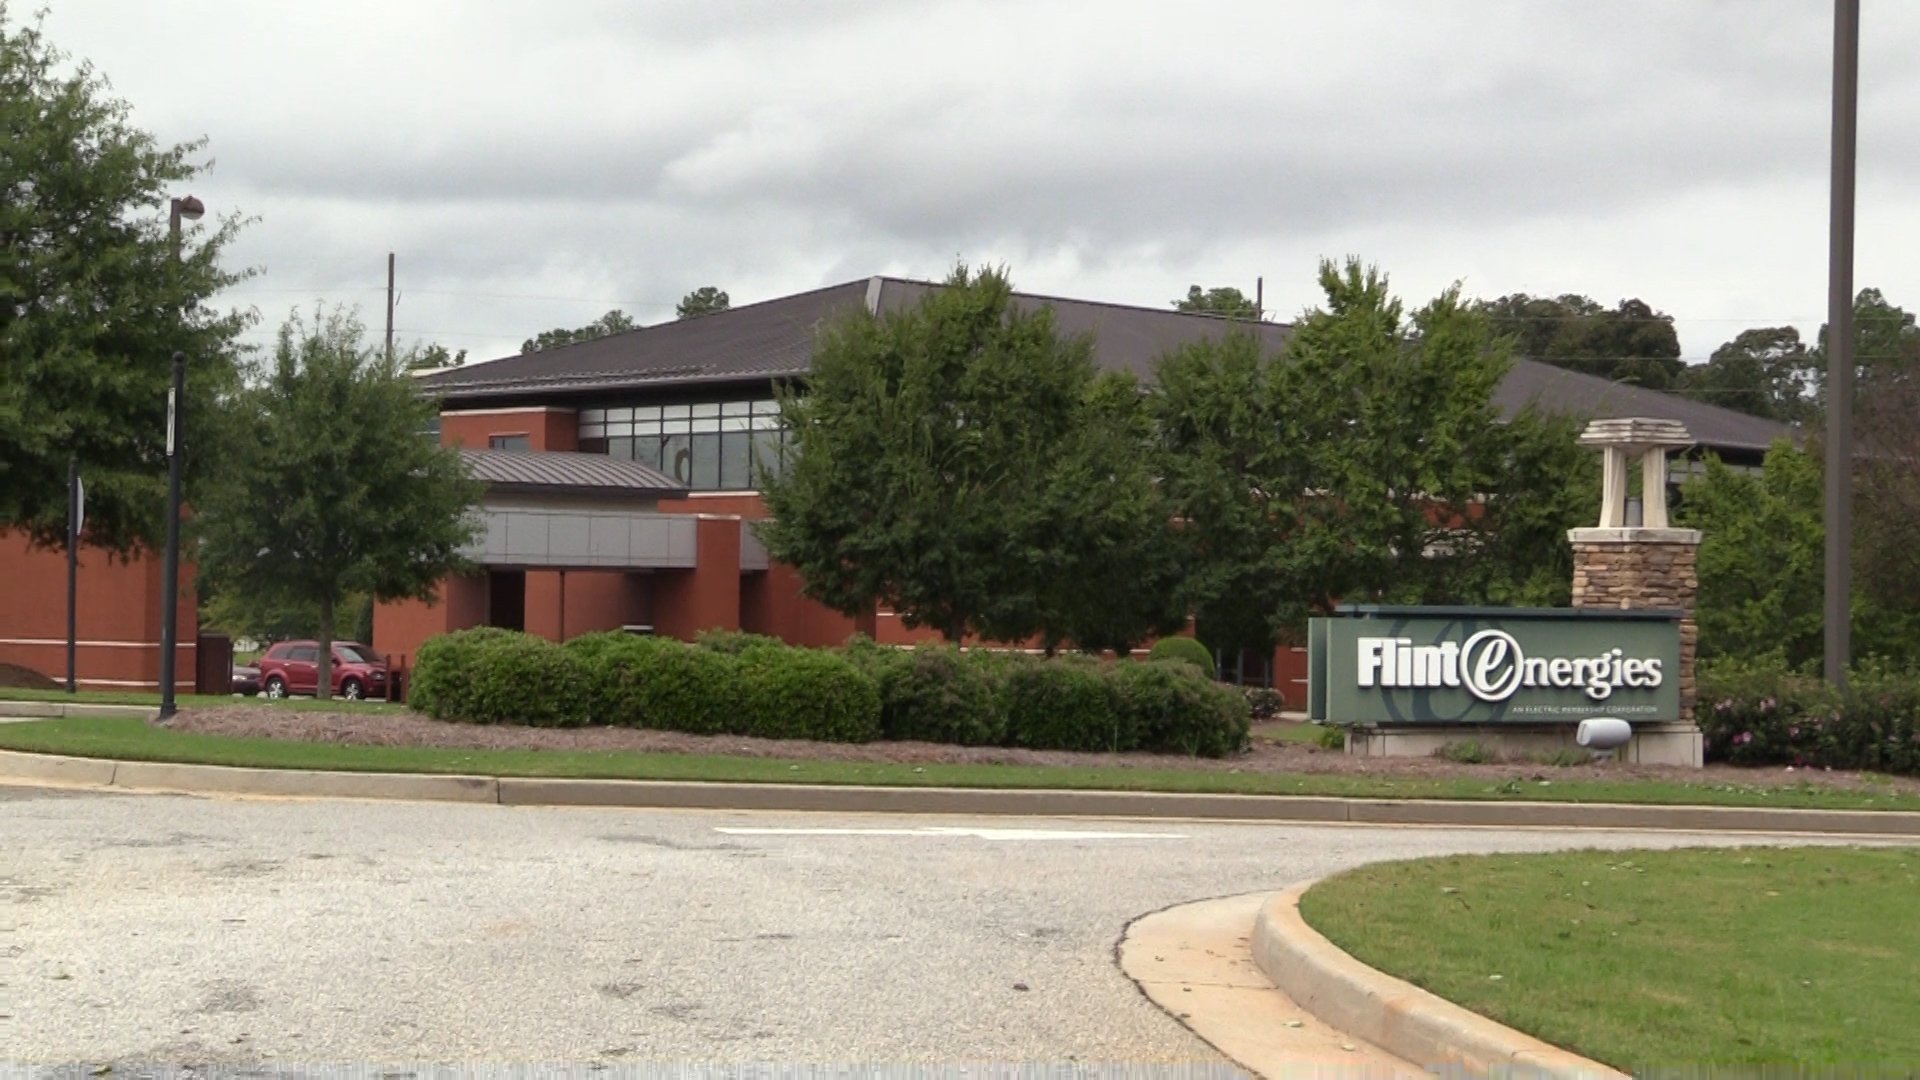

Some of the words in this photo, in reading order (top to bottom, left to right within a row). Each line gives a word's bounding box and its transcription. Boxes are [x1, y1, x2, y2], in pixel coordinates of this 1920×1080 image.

[1357, 637, 1460, 687] Flint
[1512, 705, 1524, 714] AN
[1525, 705, 1560, 714] ELECTRIC
[1606, 705, 1658, 714] CORPORATION
